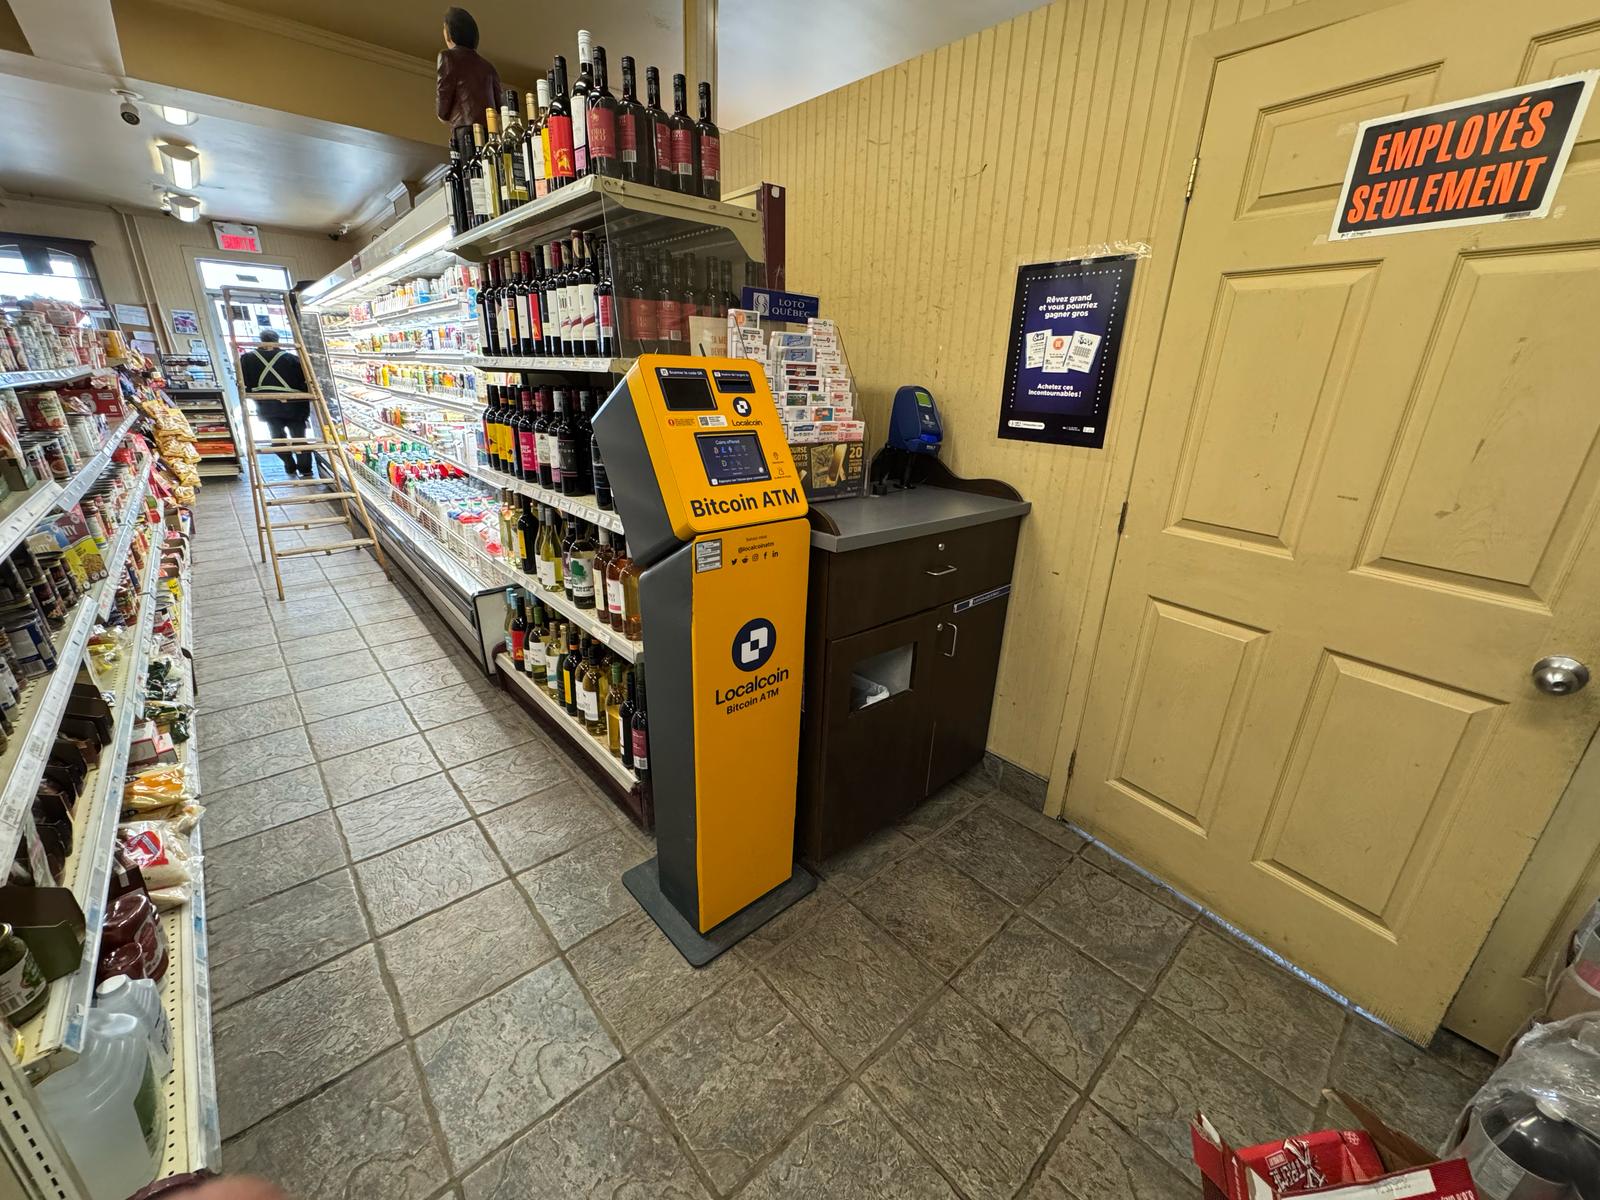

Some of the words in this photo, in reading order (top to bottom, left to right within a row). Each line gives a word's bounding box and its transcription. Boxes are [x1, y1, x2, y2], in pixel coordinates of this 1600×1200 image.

[1367, 97, 1555, 176] EMPLOYÉS
[1347, 156, 1548, 224] SEULEMENT
[778, 297, 806, 309] LOTO
[1046, 295, 1069, 303] Rêvez
[1069, 294, 1093, 304] grand
[771, 305, 811, 319] QUÉBEC
[1038, 303, 1047, 311] et
[1065, 302, 1099, 311] pourriez
[1044, 311, 1071, 320] gagner
[1071, 310, 1089, 319] gros
[732, 419, 763, 427] Localcoin
[849, 446, 863, 459] 20
[690, 493, 759, 518] Bitcoin
[763, 488, 800, 507] ATM
[738, 542, 775, 553] @localcoinatm
[715, 668, 789, 706] Localcoin
[726, 697, 759, 715] Bitcoin
[760, 687, 780, 703] ATM
